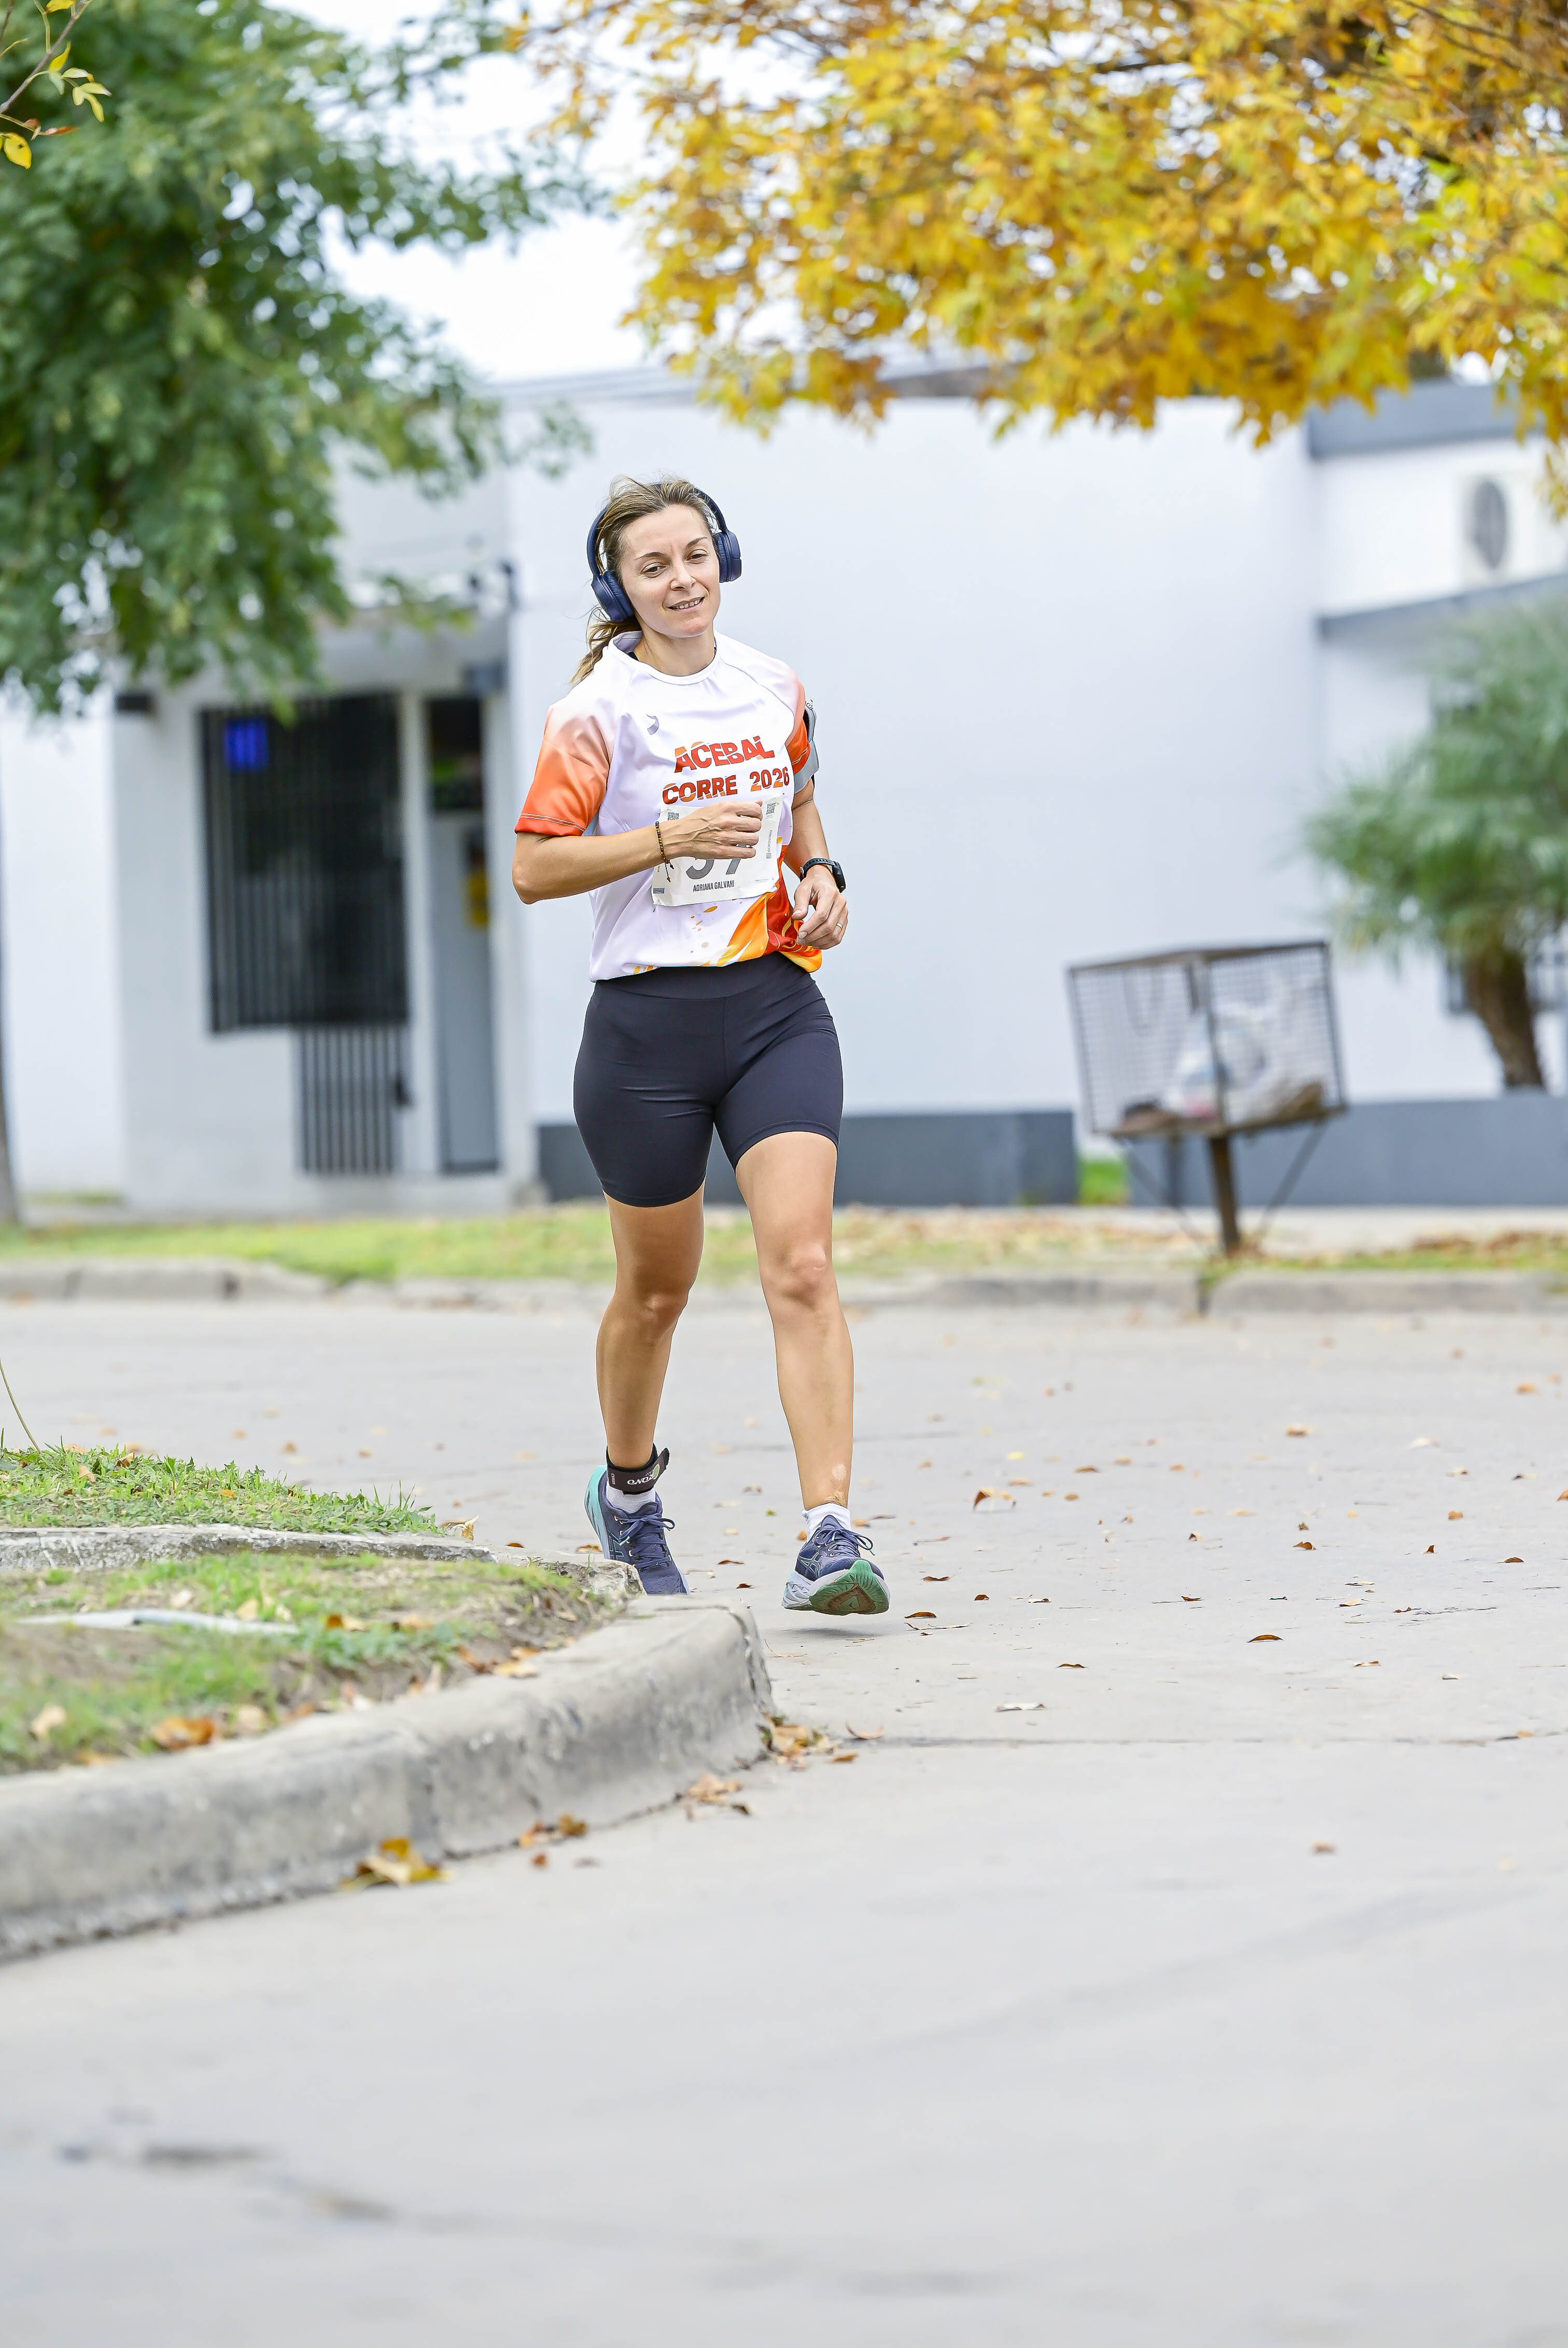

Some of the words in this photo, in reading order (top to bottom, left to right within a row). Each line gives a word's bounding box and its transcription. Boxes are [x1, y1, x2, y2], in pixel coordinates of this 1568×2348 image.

[675, 736, 775, 773] ACEBAL
[663, 775, 737, 804] CORRE
[750, 767, 789, 791] 2026
[693, 883, 713, 892] ADRIANA
[715, 880, 734, 889] GALVANI
